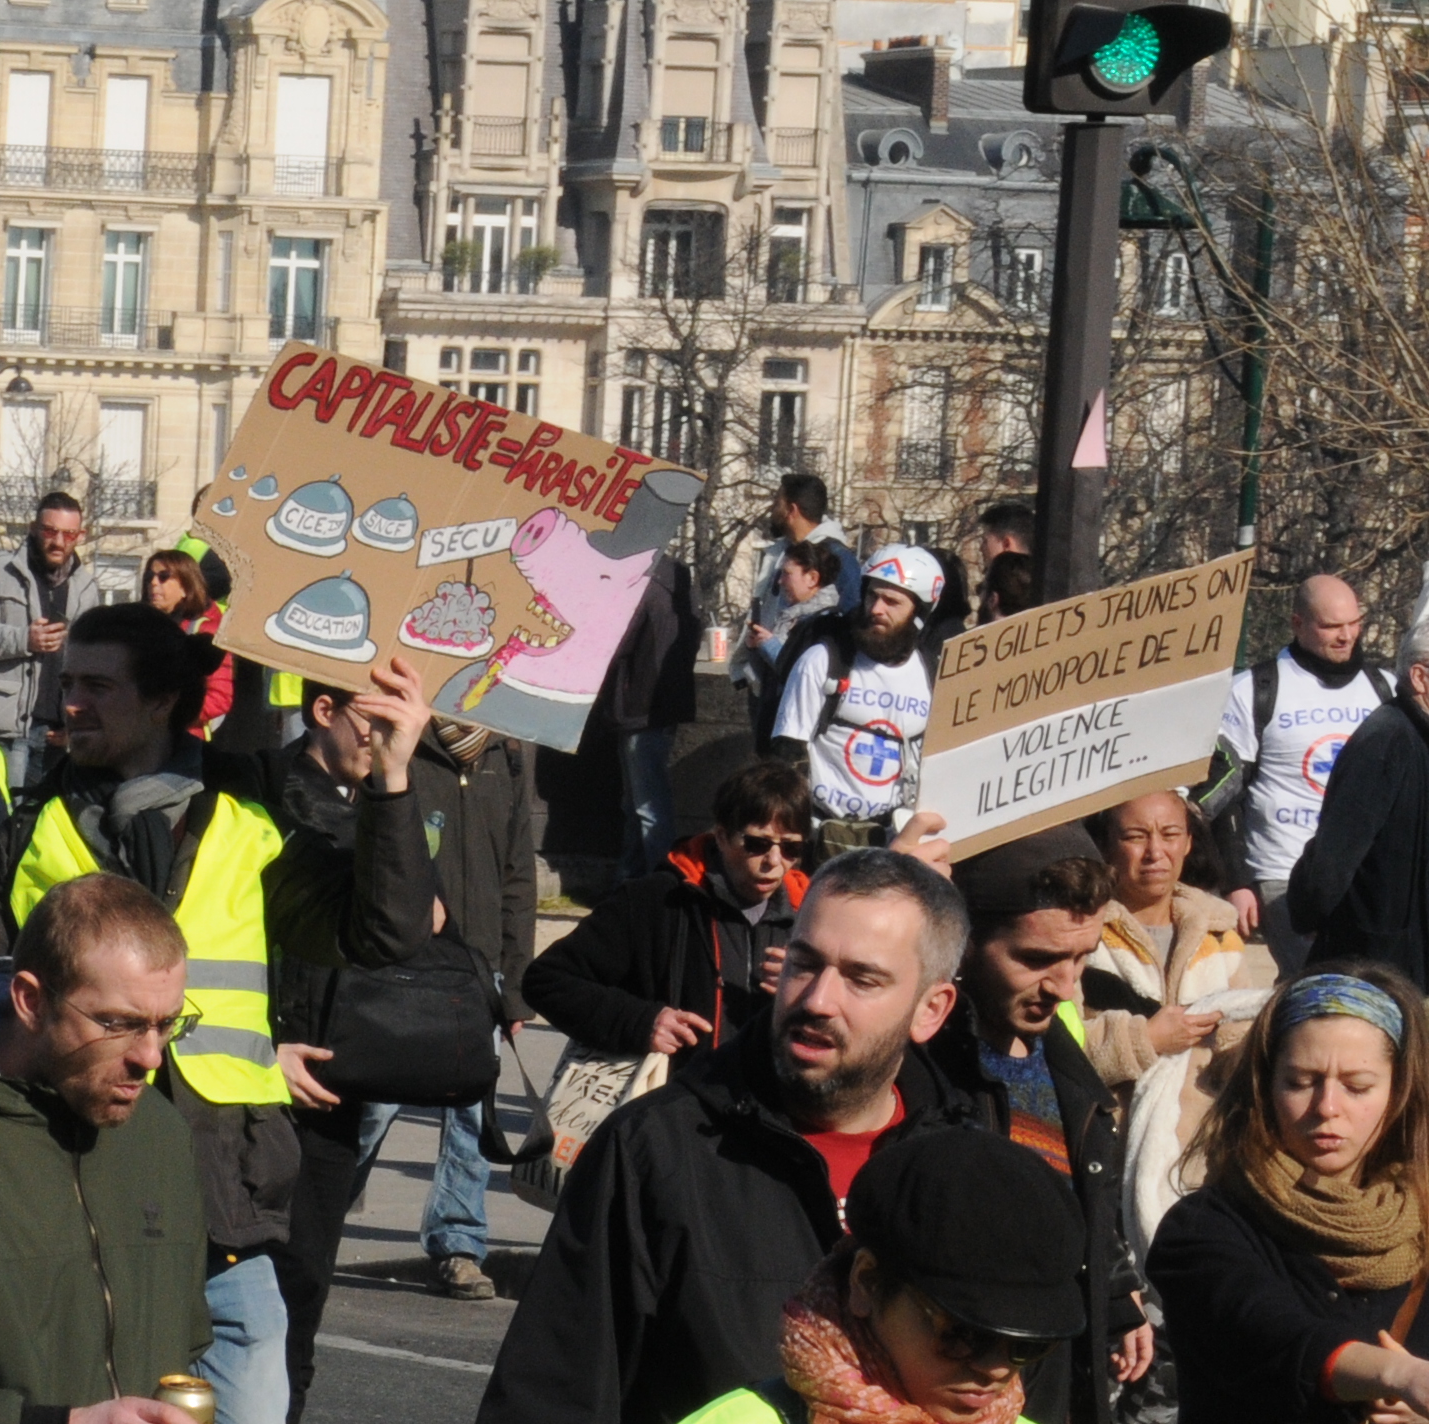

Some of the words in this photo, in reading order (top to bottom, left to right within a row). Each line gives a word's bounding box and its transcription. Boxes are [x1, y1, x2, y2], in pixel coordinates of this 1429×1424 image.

[364, 514, 407, 537] SNCF
[287, 606, 361, 635] EDUCATION
[939, 634, 988, 681] LES
[994, 602, 1086, 662] GILETS
[1097, 574, 1200, 629] JAUNES
[1207, 557, 1255, 601] ONT
[952, 689, 982, 728] LE
[992, 640, 1134, 713] MONOPOLE
[1138, 628, 1178, 670] DE
[1183, 614, 1224, 657] LA
[842, 686, 929, 718] ECOURS
[1002, 698, 1129, 763] VIOLENCE
